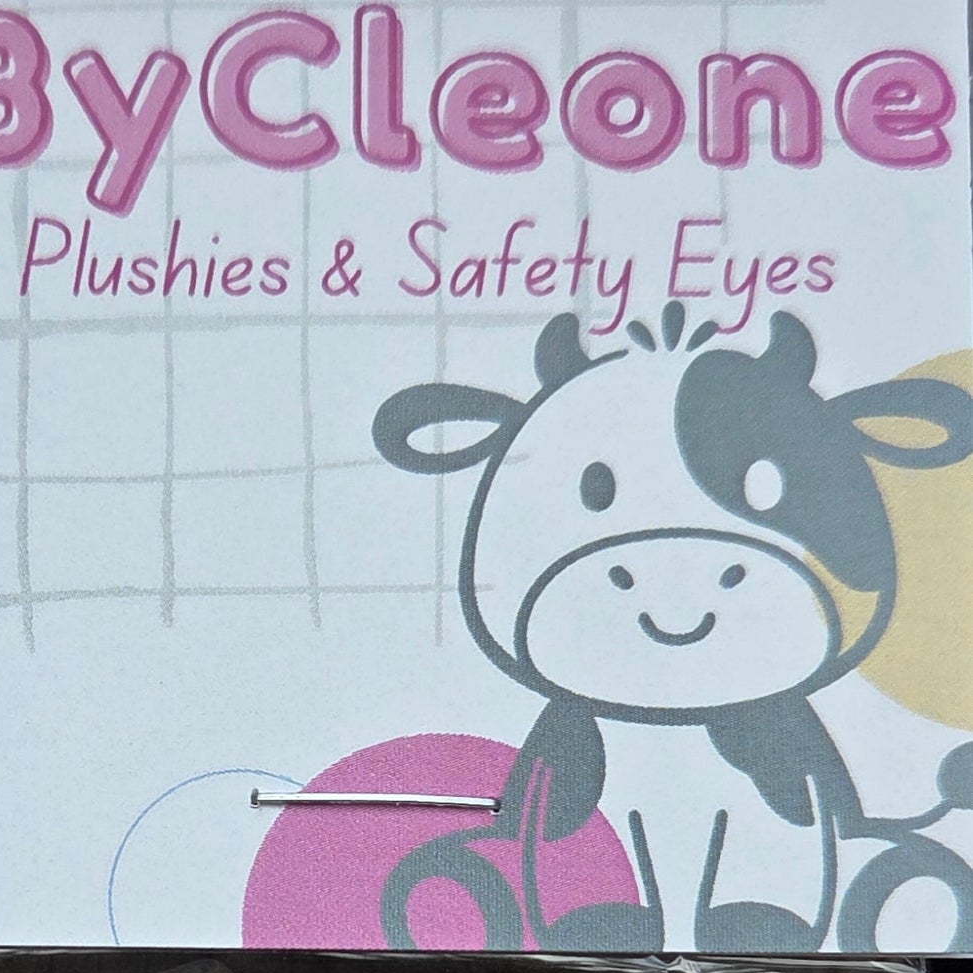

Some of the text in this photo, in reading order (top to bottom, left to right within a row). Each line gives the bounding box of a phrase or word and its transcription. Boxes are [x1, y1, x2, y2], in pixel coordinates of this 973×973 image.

[20, 217, 290, 298] Plushies
[322, 238, 363, 297] &
[399, 217, 633, 335] Safety
[668, 219, 836, 335] Eyes
